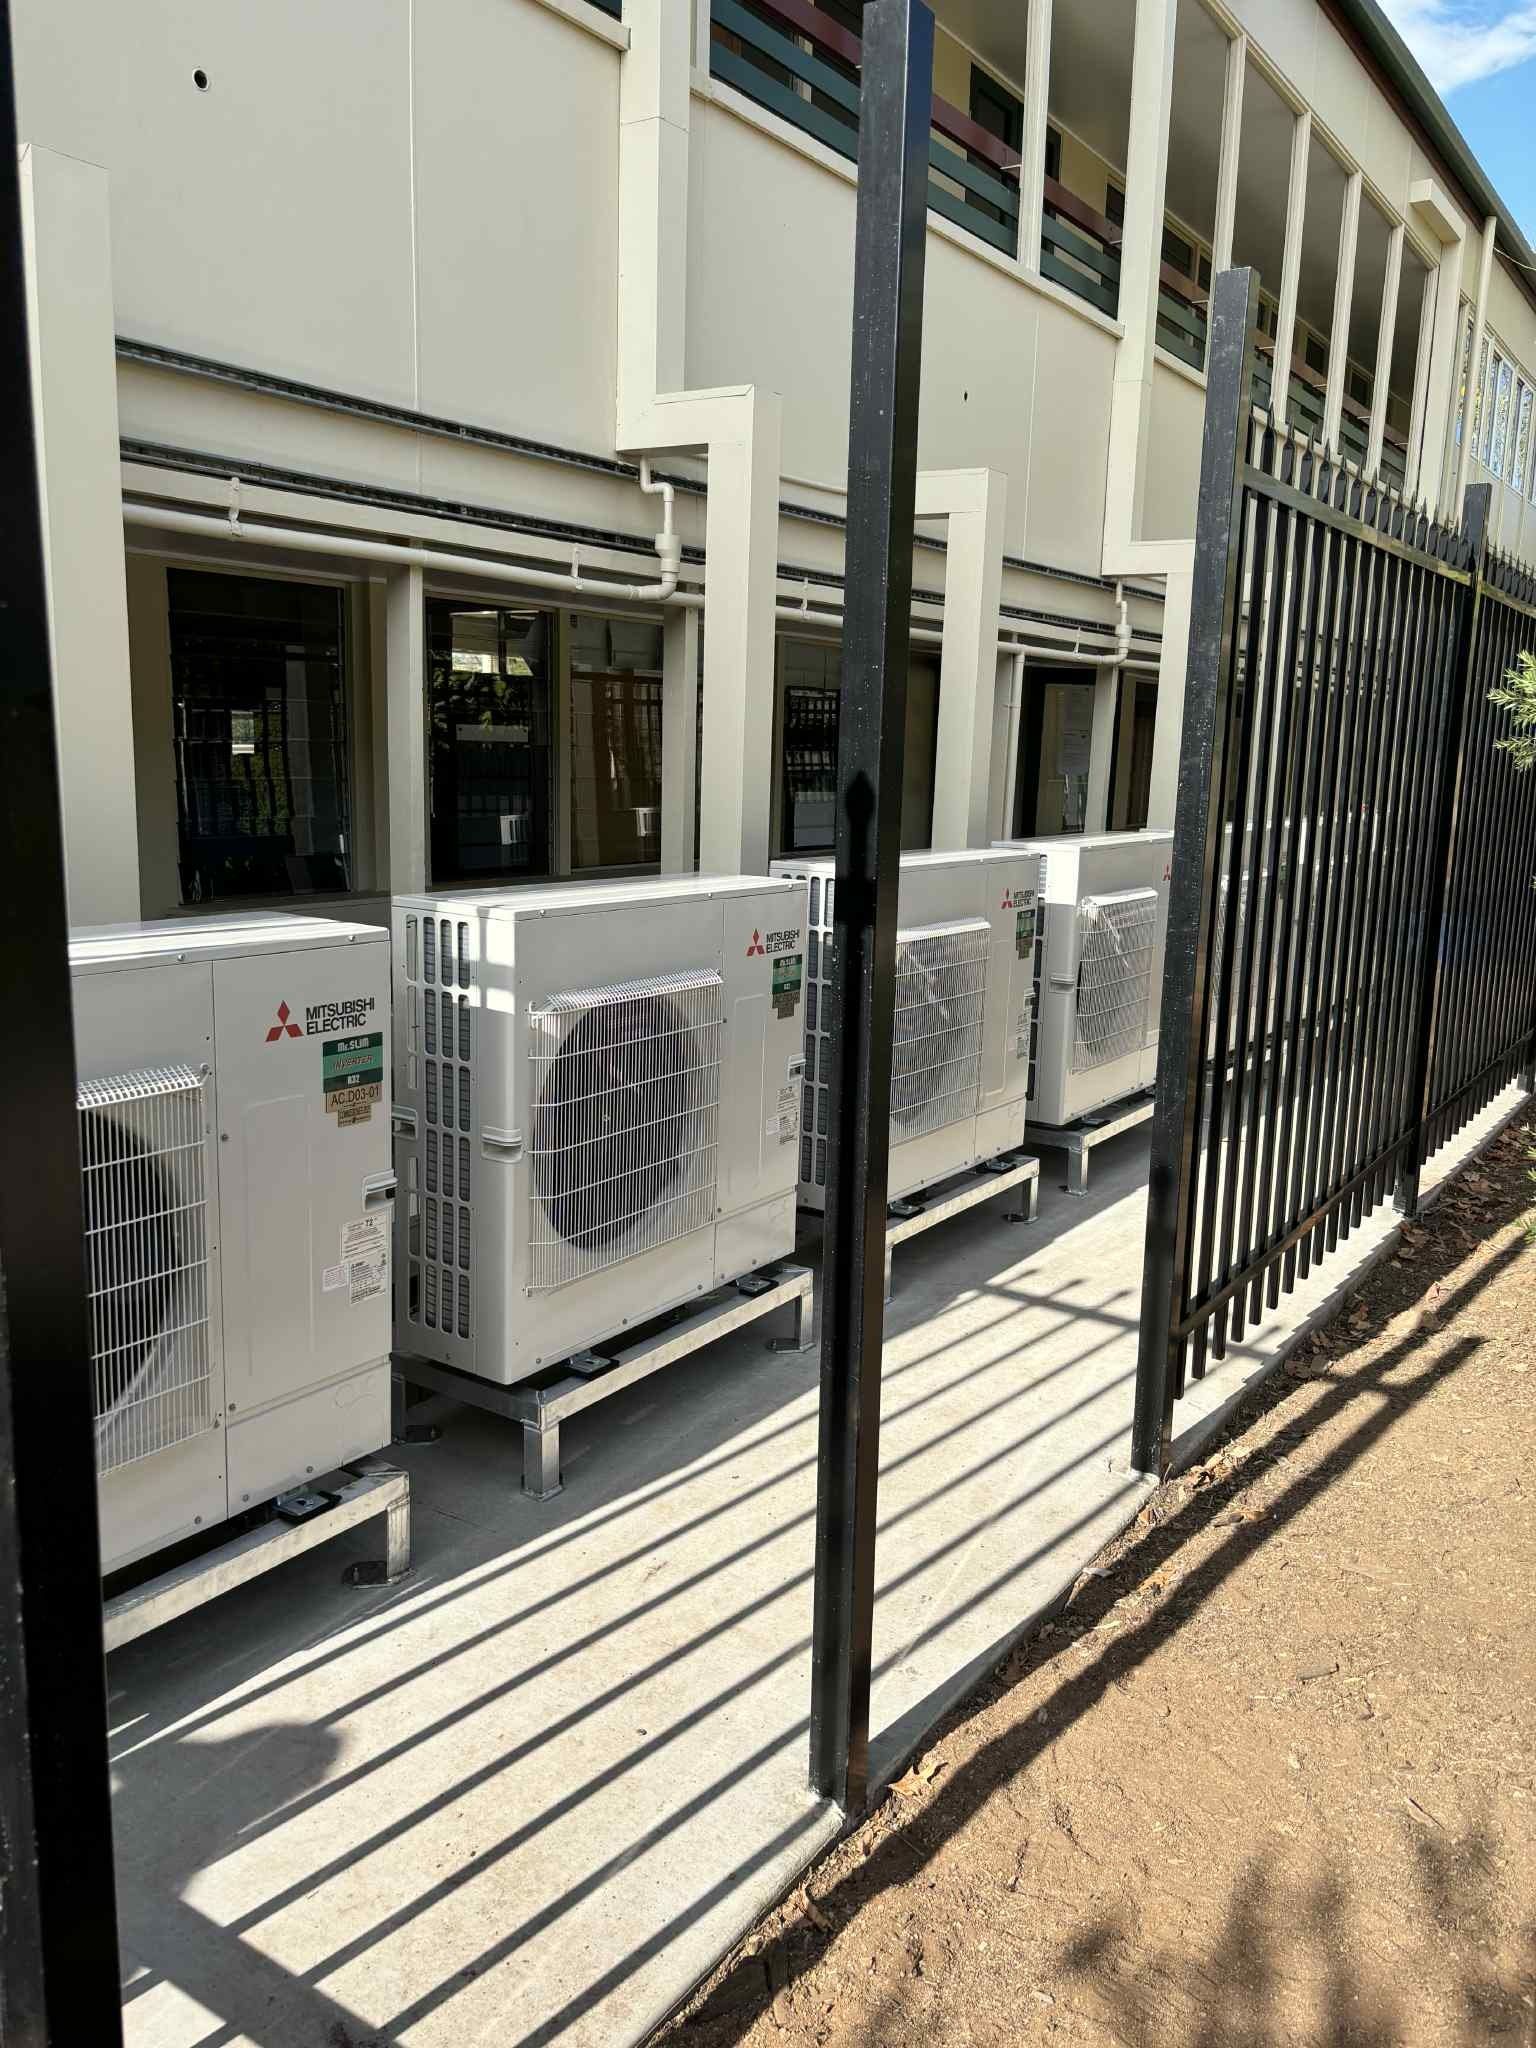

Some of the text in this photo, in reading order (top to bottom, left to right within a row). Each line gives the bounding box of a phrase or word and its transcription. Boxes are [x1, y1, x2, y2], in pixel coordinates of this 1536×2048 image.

[766, 929, 800, 943] MITSUBISHI
[766, 940, 796, 954] ELECTRIC
[306, 996, 375, 1021] MITSUBISHI
[306, 1012, 367, 1036] ELECTRIC
